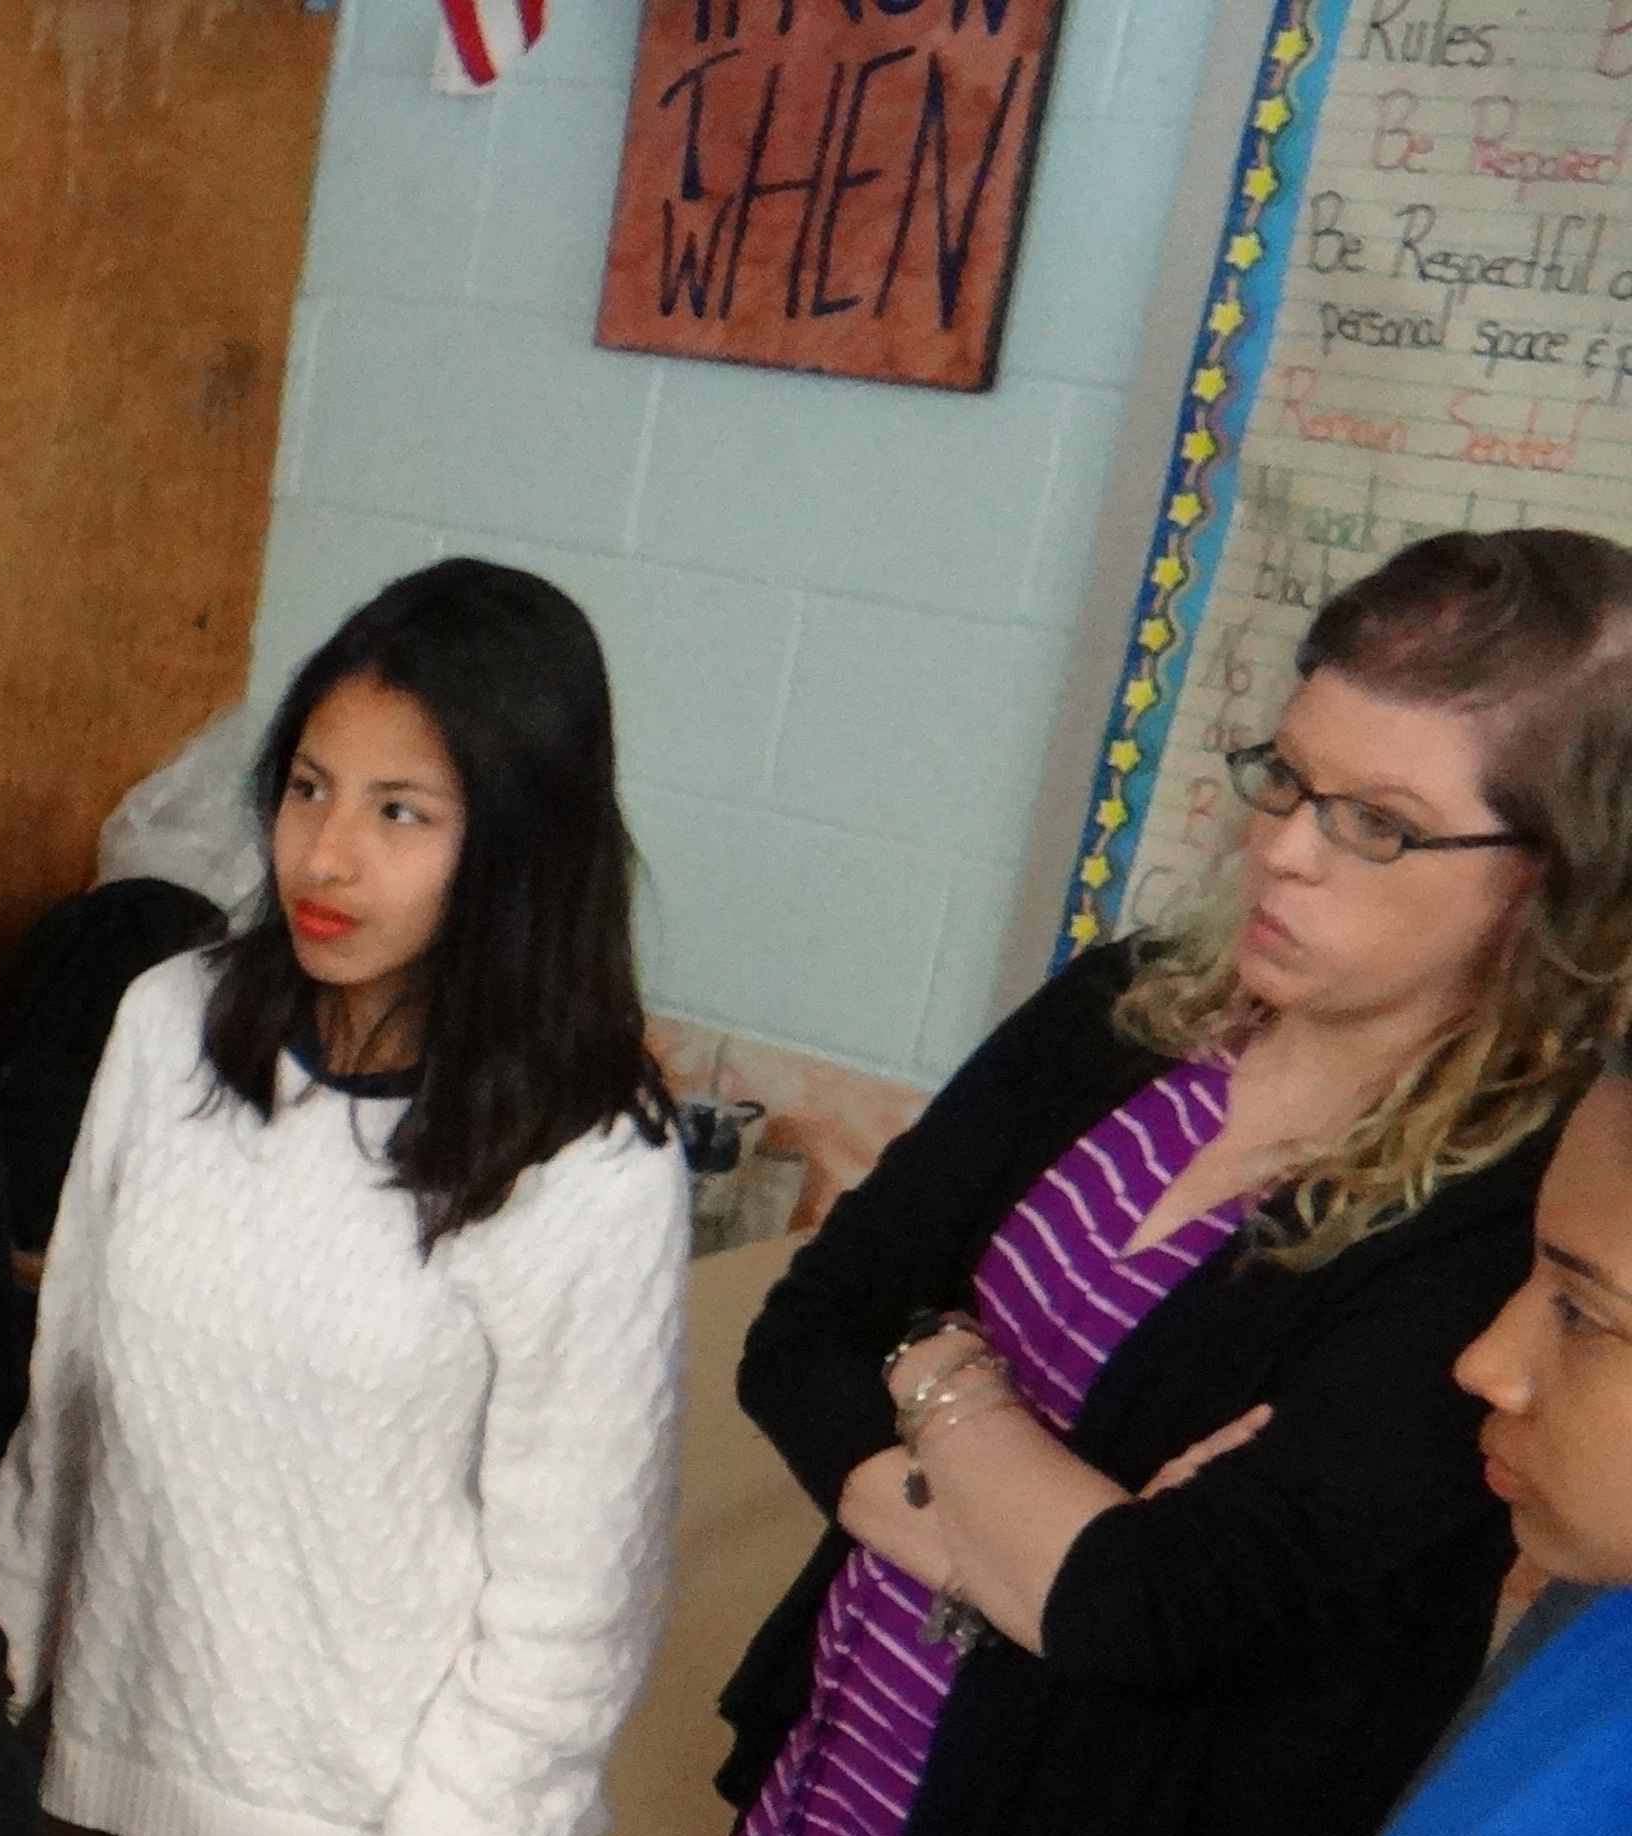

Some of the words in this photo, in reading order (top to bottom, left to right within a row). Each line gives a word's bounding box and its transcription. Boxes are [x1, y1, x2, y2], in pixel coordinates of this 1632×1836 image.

[1308, 189, 1366, 274] Be
[1390, 203, 1607, 304] Respectful
[1472, 319, 1568, 379] space
